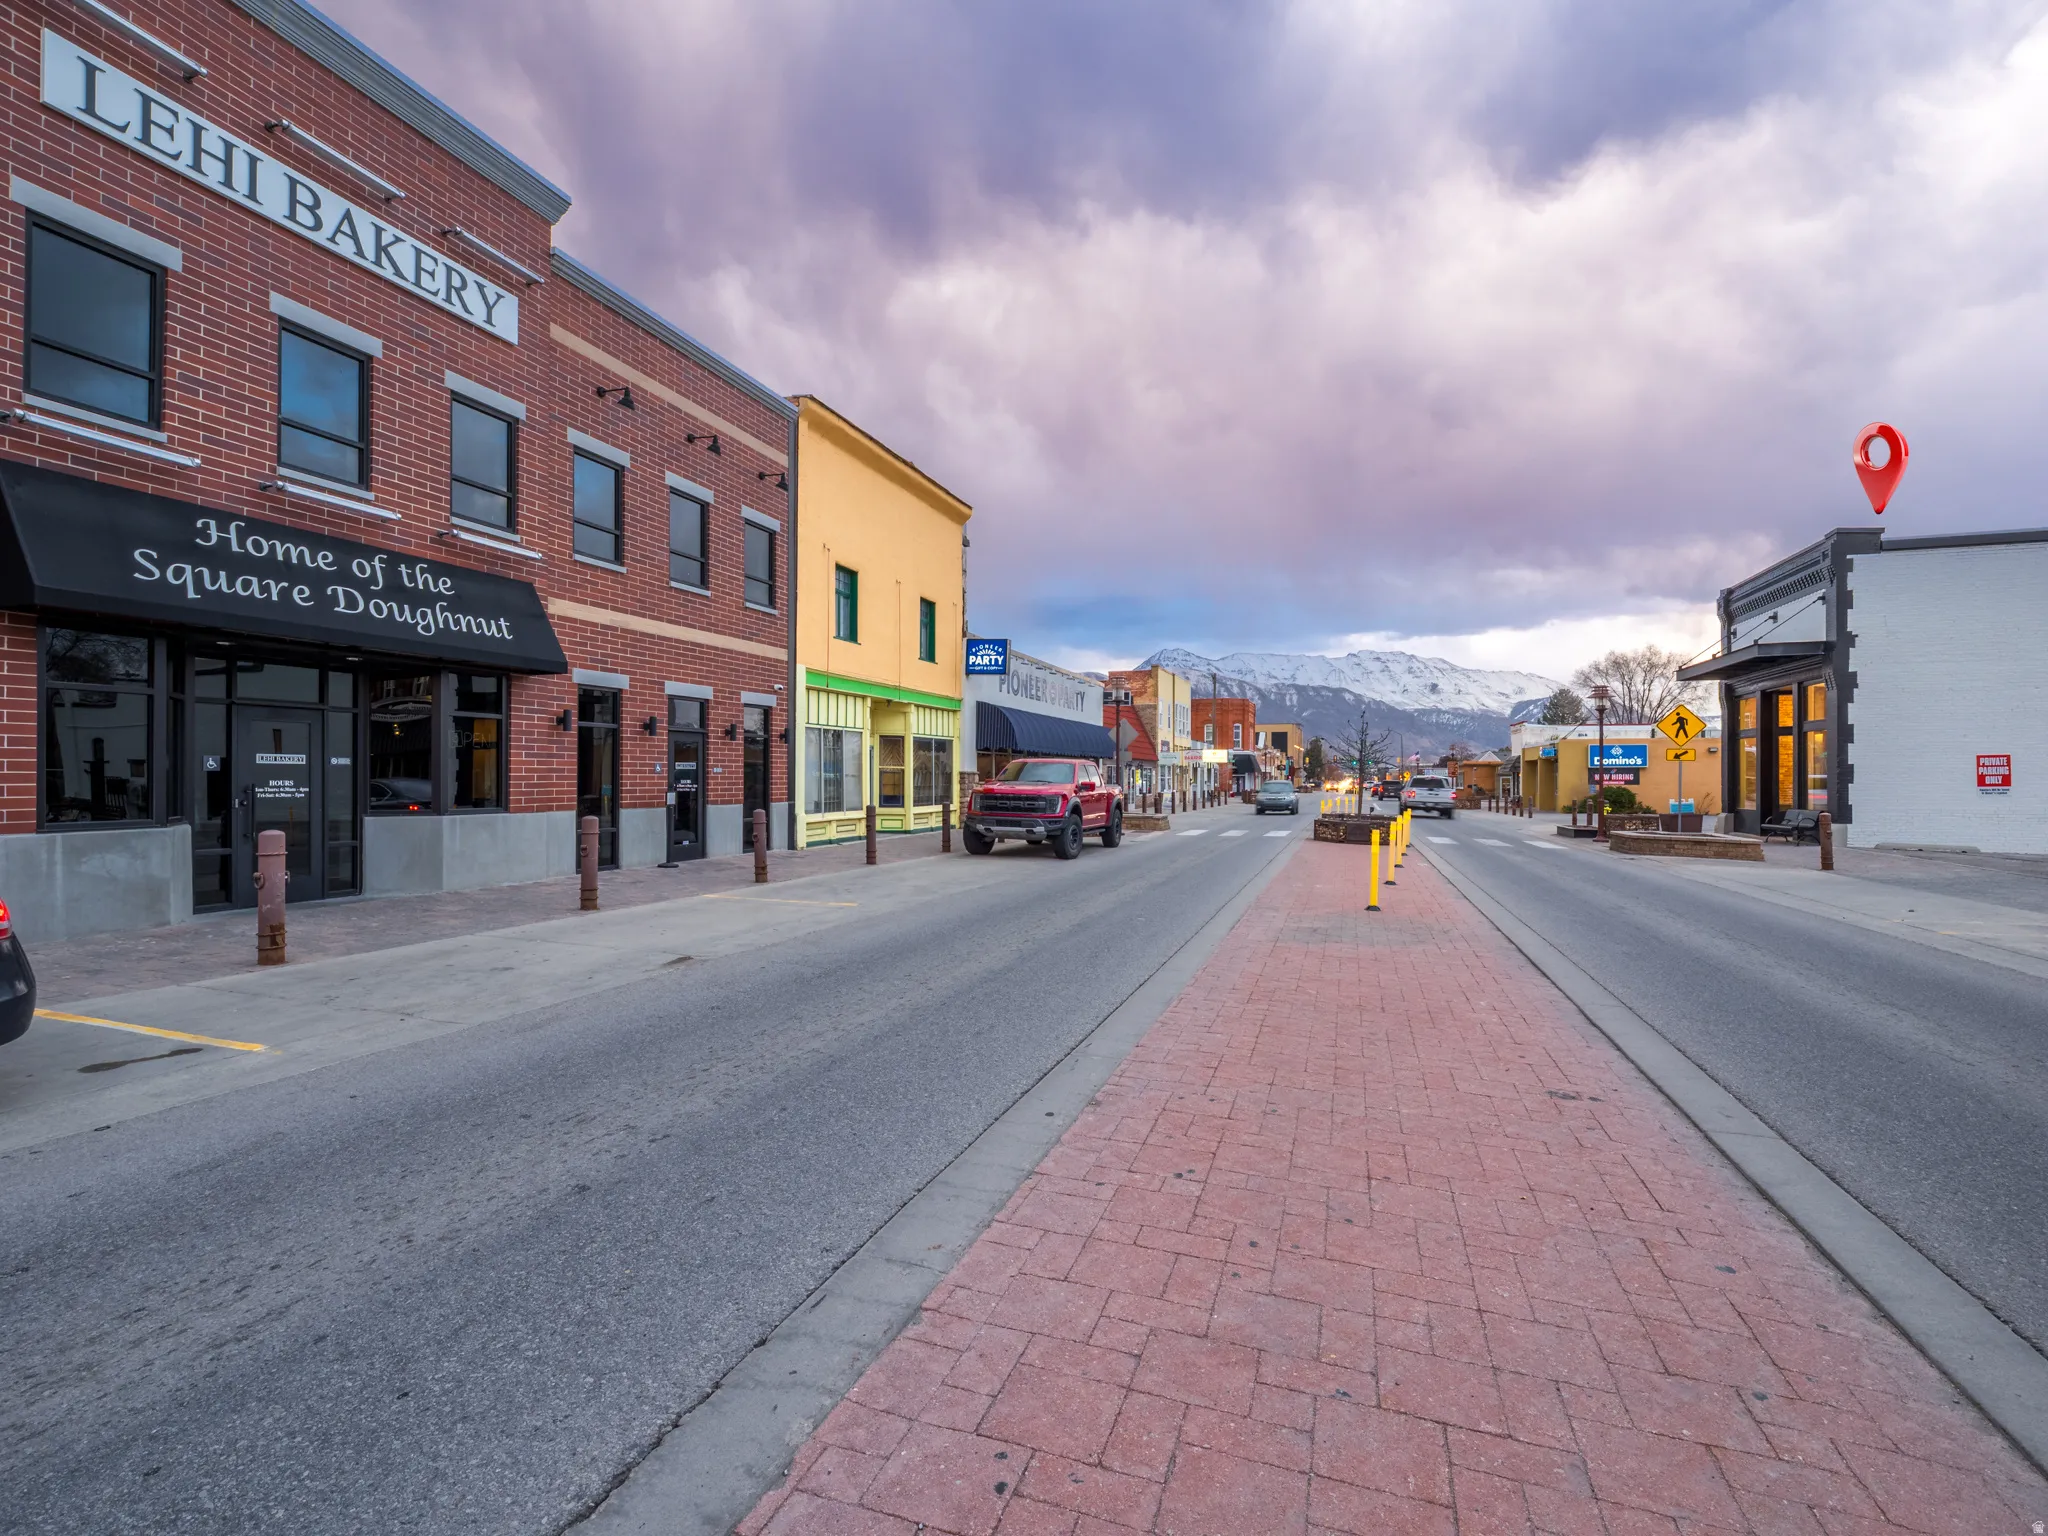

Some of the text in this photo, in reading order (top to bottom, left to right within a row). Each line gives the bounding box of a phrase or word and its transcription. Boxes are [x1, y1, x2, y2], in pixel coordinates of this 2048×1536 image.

[77, 55, 506, 328] LEHI BAKERY
[195, 518, 456, 596] Home of the
[133, 548, 514, 641] Square Doughnut
[972, 644, 1003, 653] PIONEER
[969, 655, 1004, 665] PARTY
[999, 669, 1085, 712] PIONEER PARTY
[276, 755, 303, 763] BAKERY
[1594, 756, 1643, 765] Domino's
[1980, 757, 2008, 766] PRIVATE
[1979, 766, 2009, 775] PARKING
[1611, 773, 1634, 781] HIRING
[1985, 775, 2003, 784] ONLY
[985, 800, 1039, 808] FORD
